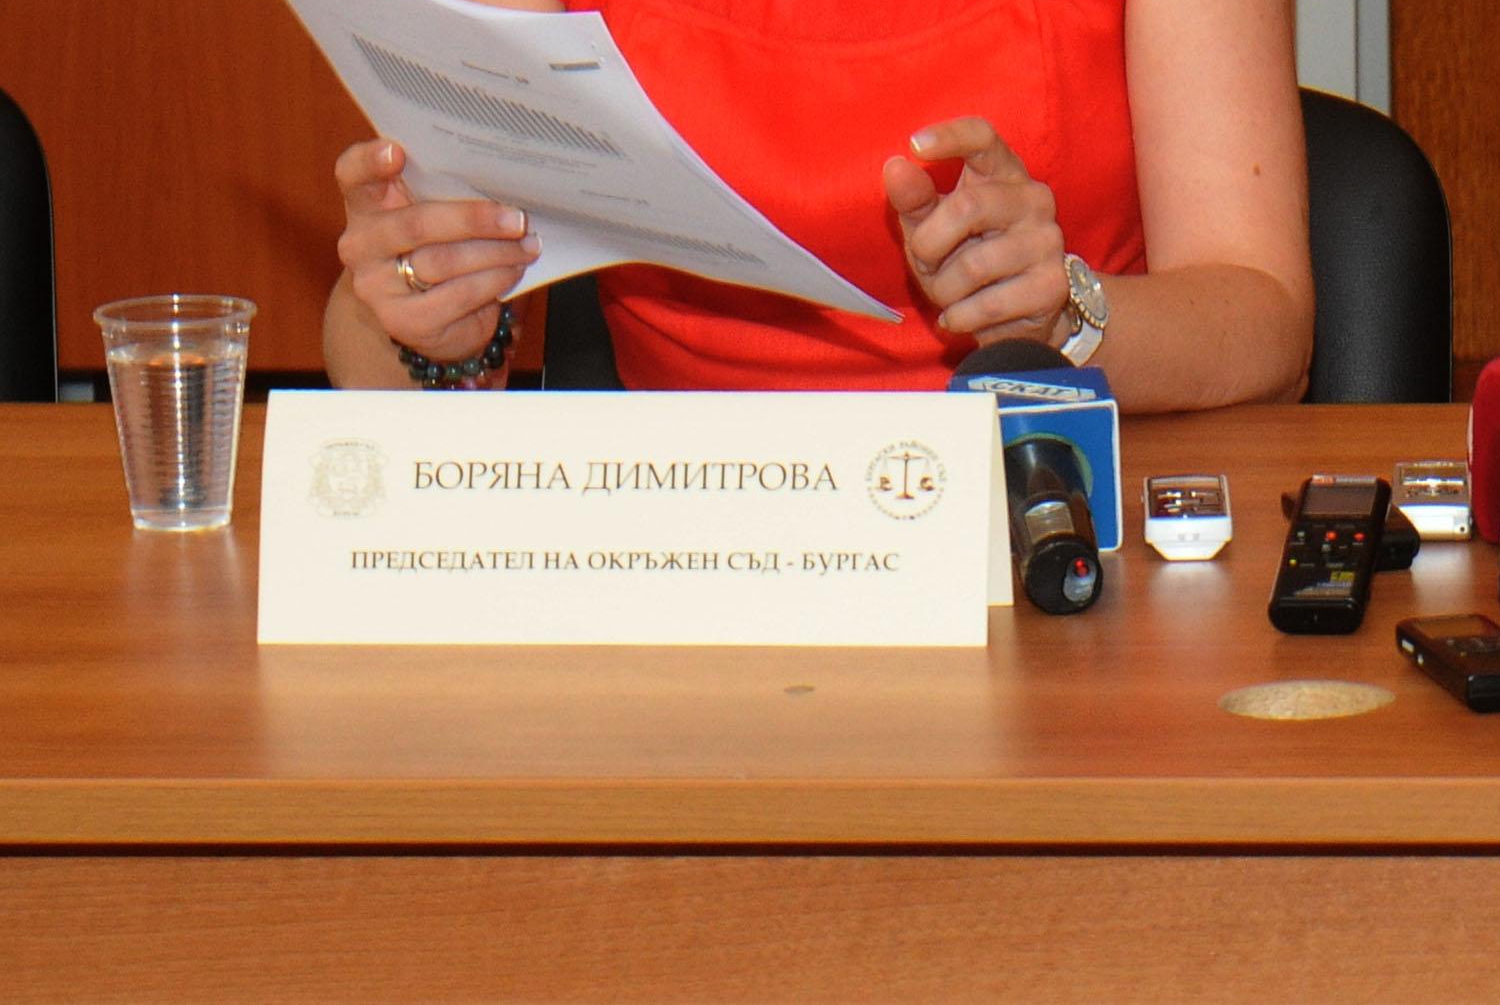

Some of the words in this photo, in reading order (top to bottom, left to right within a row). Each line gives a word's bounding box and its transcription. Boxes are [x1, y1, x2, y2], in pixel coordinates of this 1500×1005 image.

[413, 461, 571, 491] БОРЯНА
[582, 461, 839, 495] ДИМИТРОВА
[350, 550, 535, 574] ПРЕДСЕДАТЕЛ
[543, 551, 580, 571] НА
[587, 551, 720, 572] ОКРЪЖЕН
[727, 551, 780, 574] СЪД
[802, 552, 900, 576] БУРГАС
